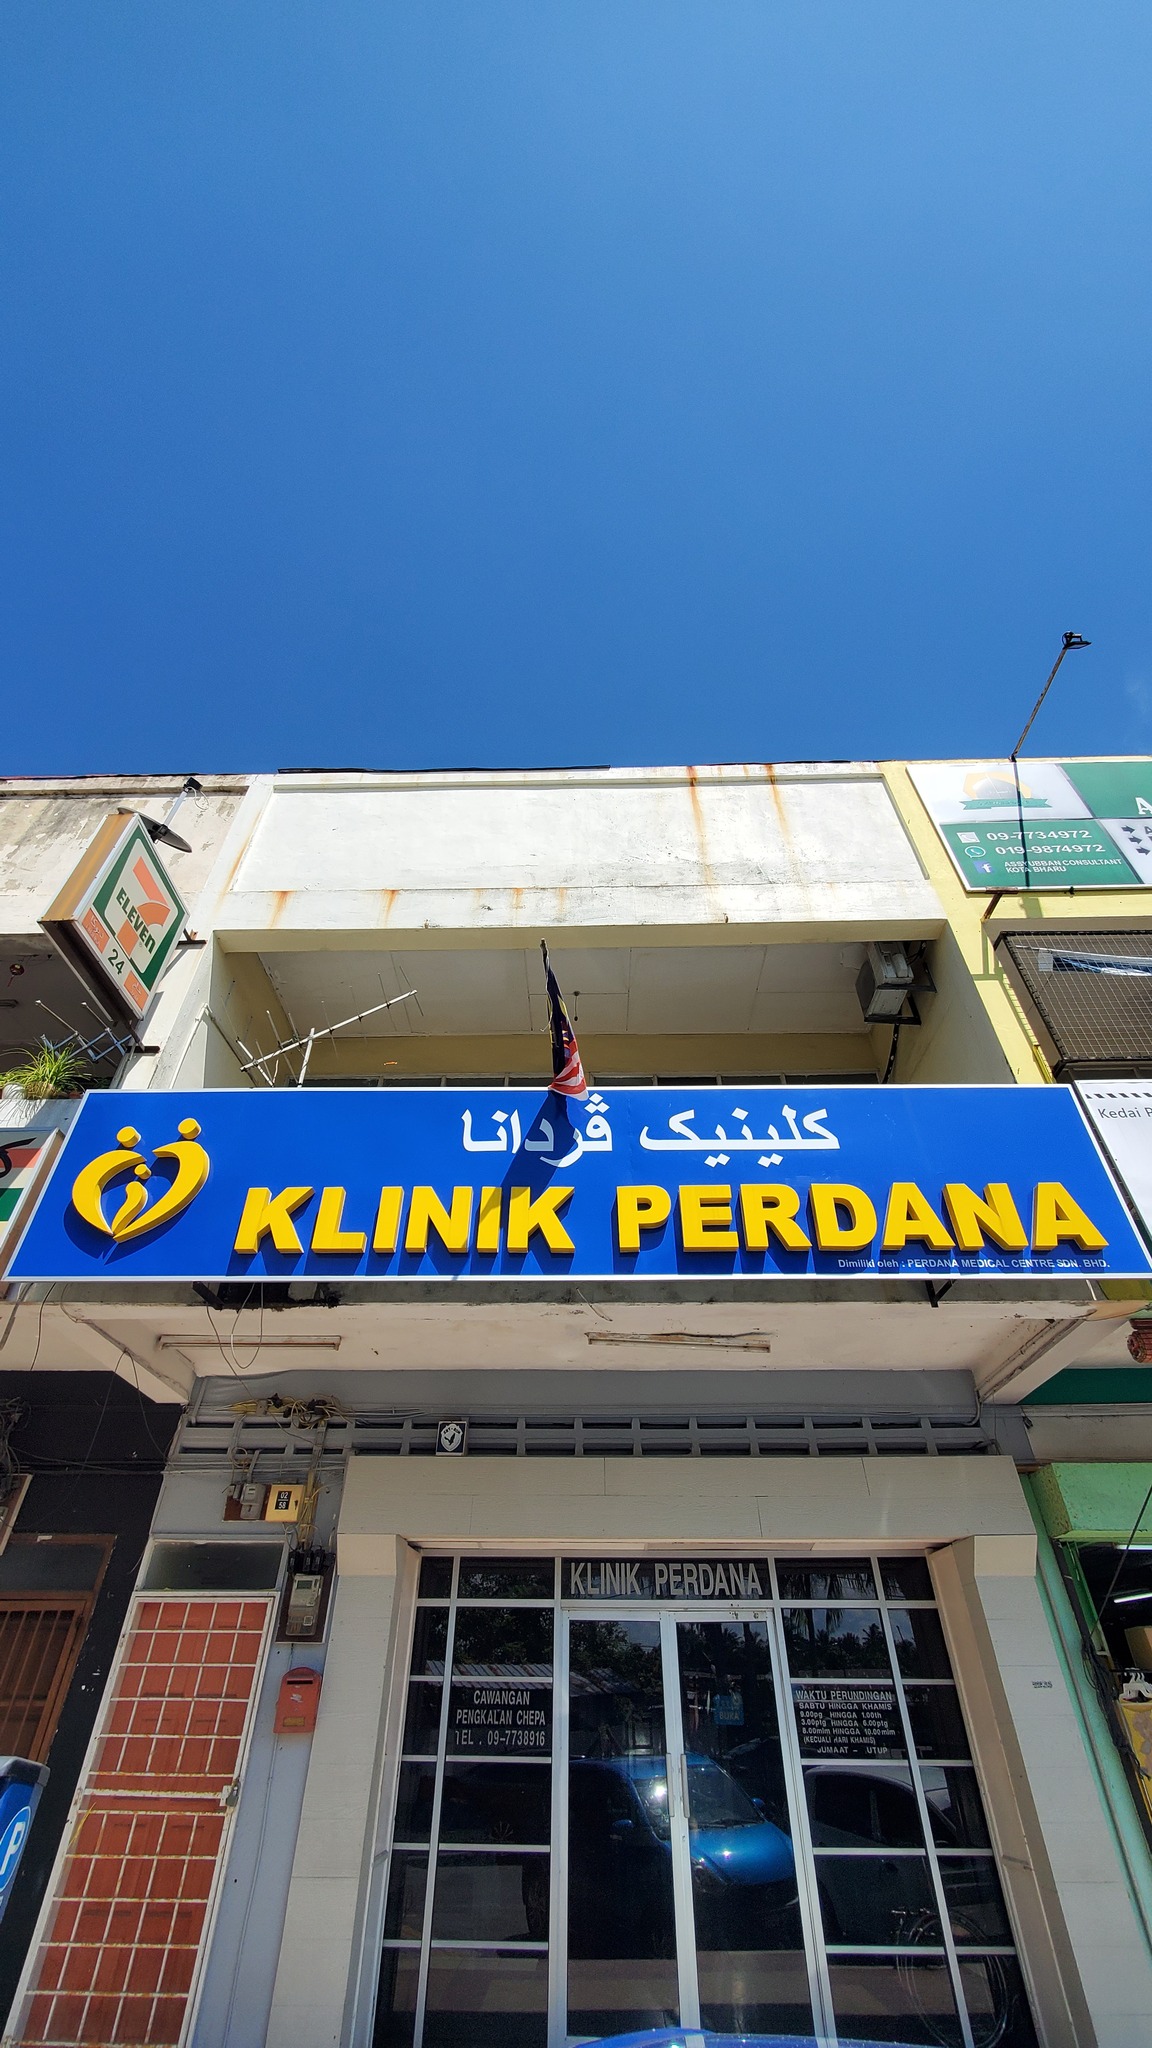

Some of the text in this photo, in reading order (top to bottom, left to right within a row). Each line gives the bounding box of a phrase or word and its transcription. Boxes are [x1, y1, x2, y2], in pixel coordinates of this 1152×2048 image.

[986, 830, 1092, 842] 09-7734972
[995, 844, 1106, 855] 019-9874972
[1062, 858, 1122, 867] CONSULTANT
[1006, 866, 1032, 874] KOTA
[107, 948, 125, 975] 24
[1097, 1106, 1142, 1119] Kedai
[233, 1182, 1109, 1254] KLINIK PERDANA
[838, 1259, 875, 1268] Dimiliki
[877, 1259, 899, 1268] oleh
[907, 1259, 959, 1268] PERDANA
[962, 1259, 1010, 1268] MEDICAL
[1012, 1259, 1055, 1268] CENTRE
[1057, 1259, 1082, 1268] SDN.
[1083, 1259, 1110, 1268] BHD.
[570, 1562, 763, 1596] KLINIK PERDANA
[473, 1690, 530, 1705] CAWANGAN
[795, 1690, 893, 1701] WAKTU PERUNDINGAN
[798, 1702, 826, 1710] SABTU
[862, 1703, 893, 1711] KHAMIS
[456, 1709, 546, 1726] PENGKALAN CHEPA
[830, 1711, 858, 1719] HINGGA
[831, 1719, 859, 1727] HINGGA
[487, 1730, 546, 1746] 09-7738916
